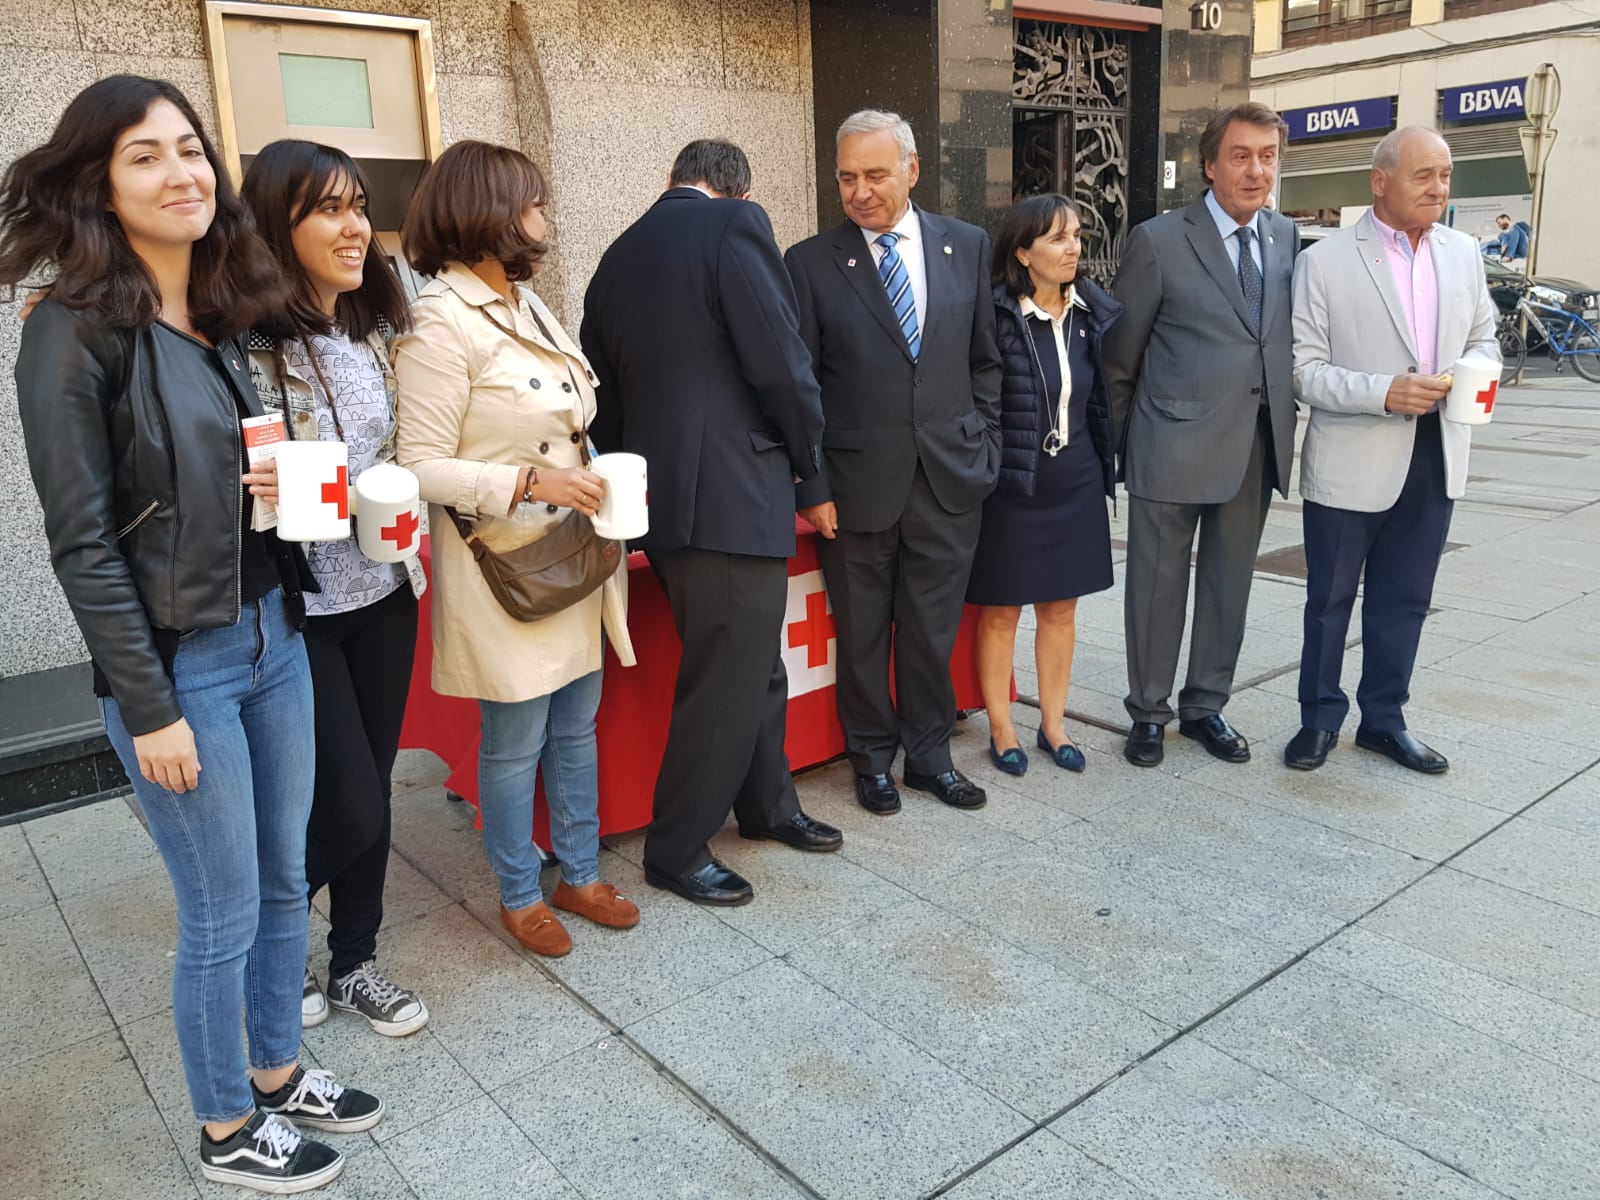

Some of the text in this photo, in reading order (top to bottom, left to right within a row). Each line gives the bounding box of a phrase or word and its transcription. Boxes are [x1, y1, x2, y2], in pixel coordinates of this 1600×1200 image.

[1200, 1, 1222, 30] 10
[1459, 86, 1523, 114] BBVA
[1306, 107, 1360, 132] BBVA
